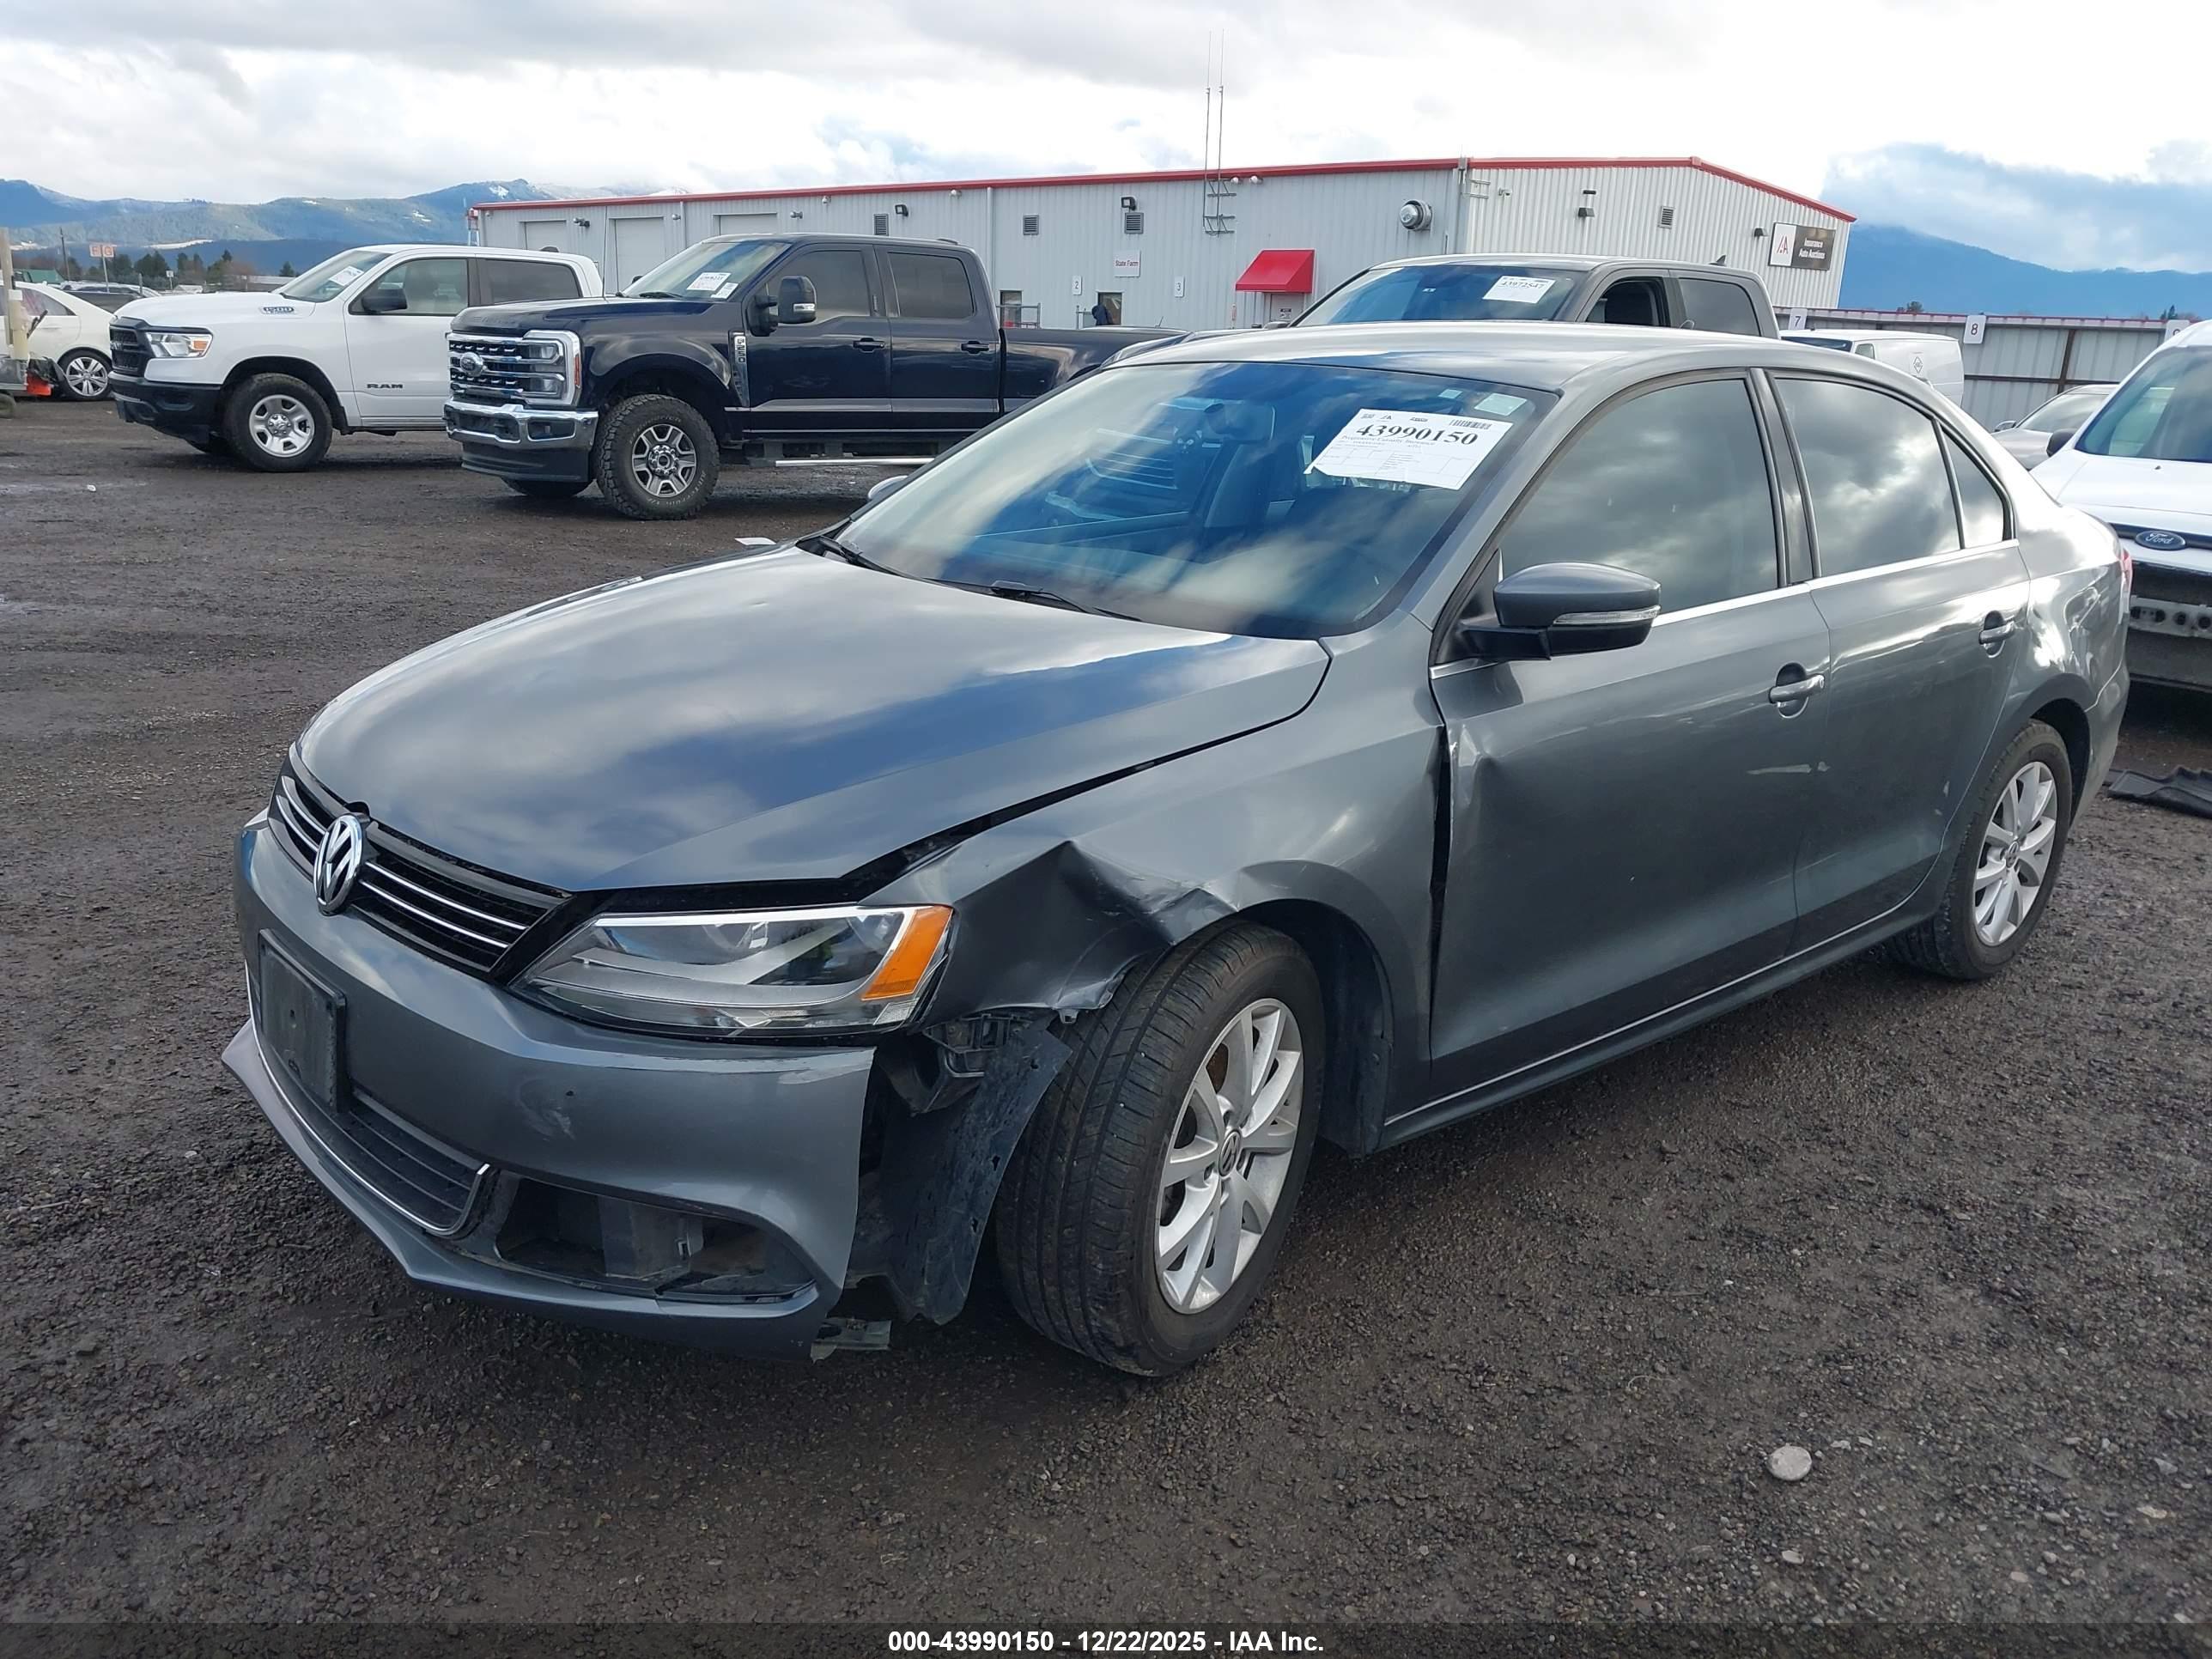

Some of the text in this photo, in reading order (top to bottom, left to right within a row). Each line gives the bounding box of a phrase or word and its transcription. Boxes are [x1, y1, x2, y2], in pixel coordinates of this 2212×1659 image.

[1799, 248, 1808, 258] Auto
[1074, 281, 1079, 289] 2
[1176, 282, 1182, 291] 3
[1795, 315, 1802, 327] 7
[1971, 323, 1978, 336] 8
[1356, 424, 1479, 446] 43990150
[2145, 532, 2173, 545] Ford
